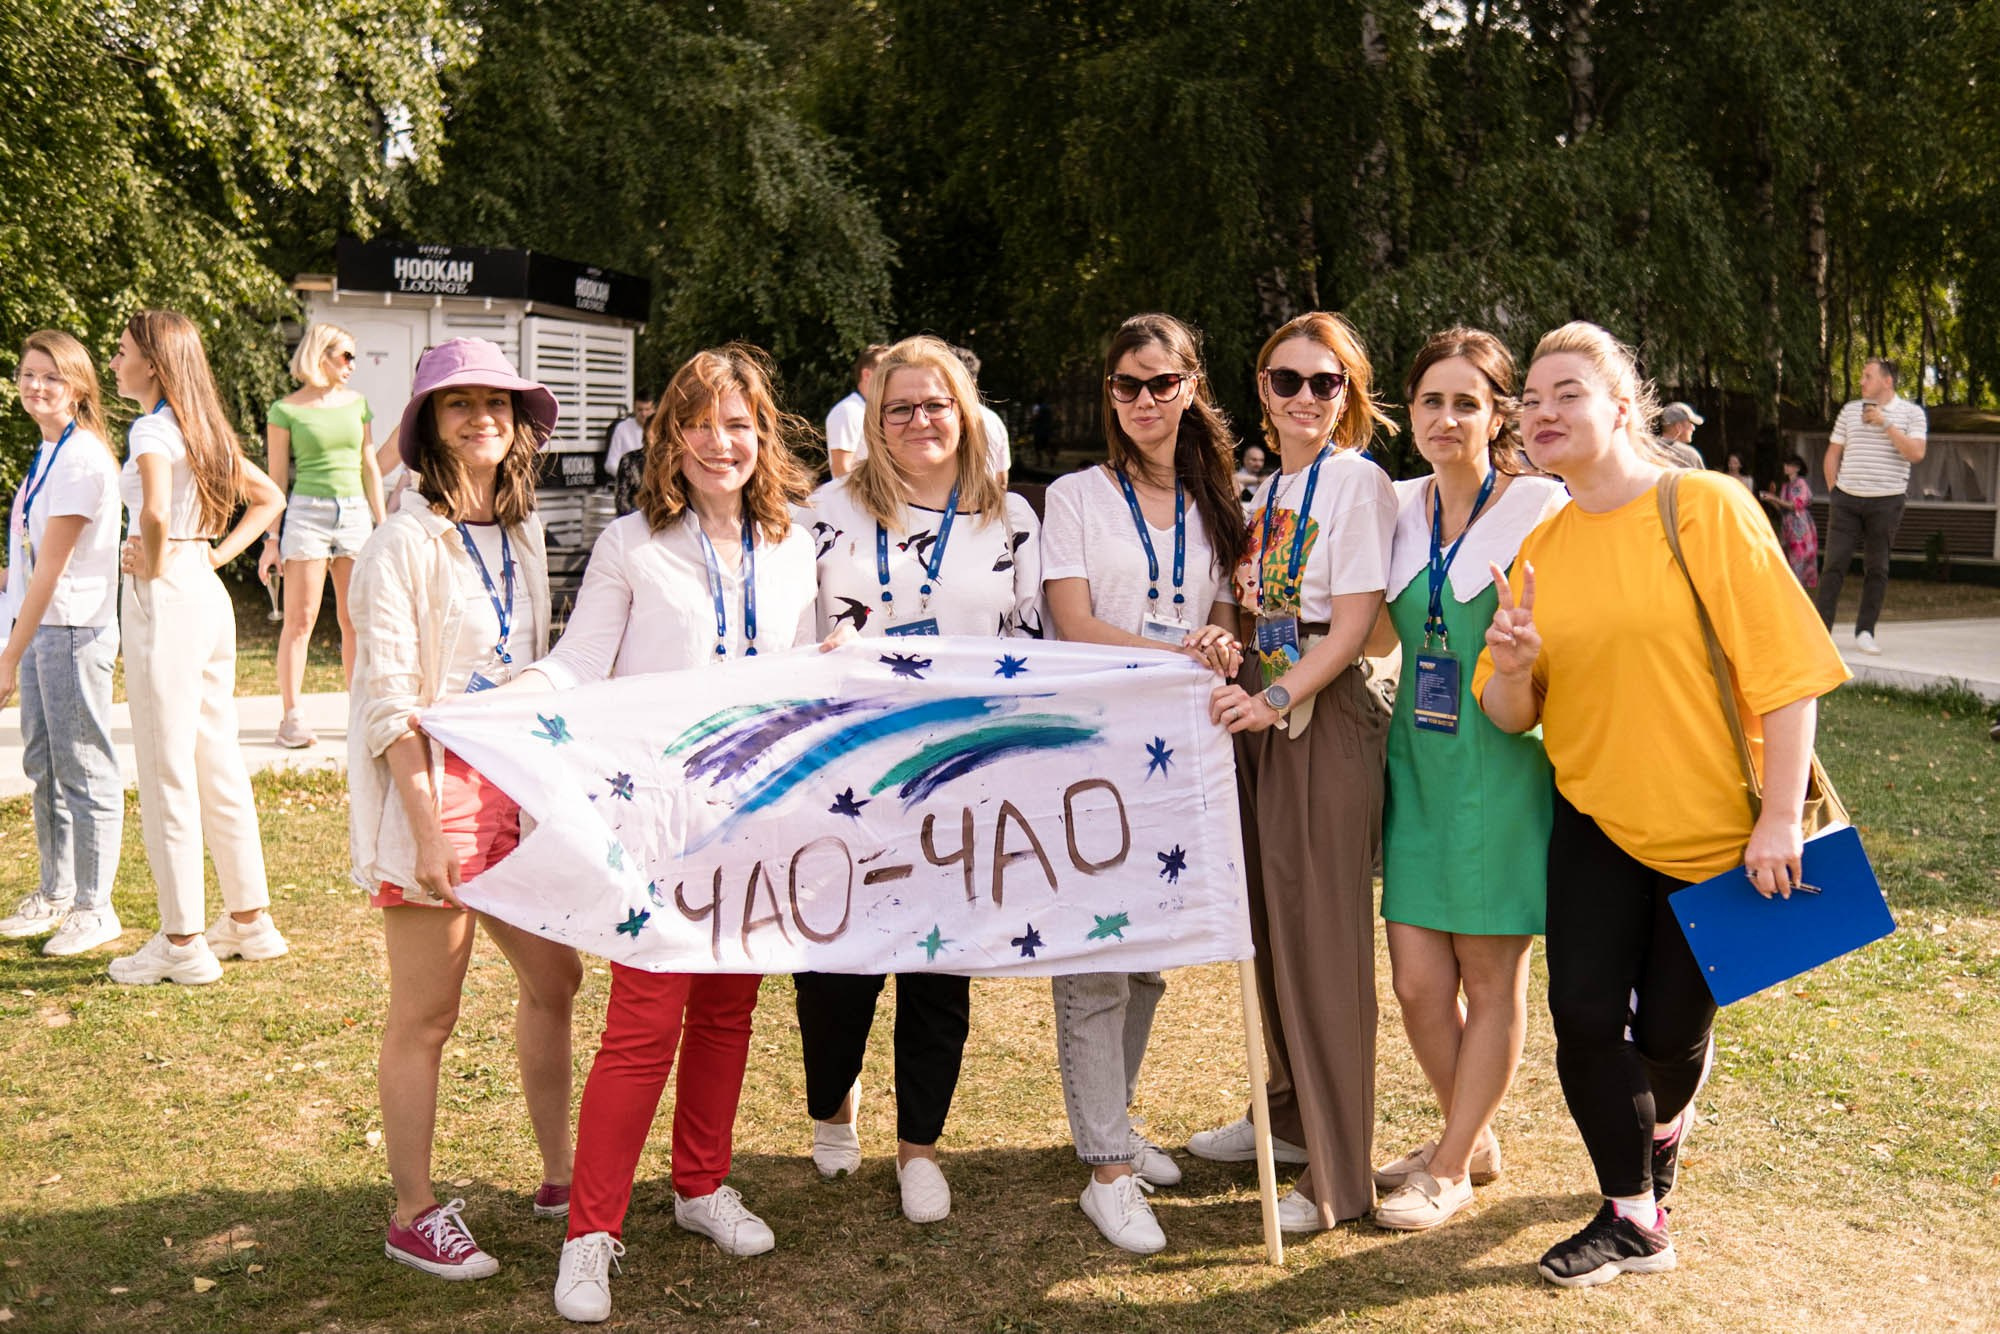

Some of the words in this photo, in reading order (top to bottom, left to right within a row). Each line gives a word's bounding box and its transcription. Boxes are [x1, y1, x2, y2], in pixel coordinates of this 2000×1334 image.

[394, 257, 474, 282] HOOKAH
[400, 279, 469, 294] LOUNGE
[575, 277, 610, 303] HOOKAH
[562, 456, 595, 475] HOOKAH
[673, 777, 1132, 964] ЧАО-ЧАО
